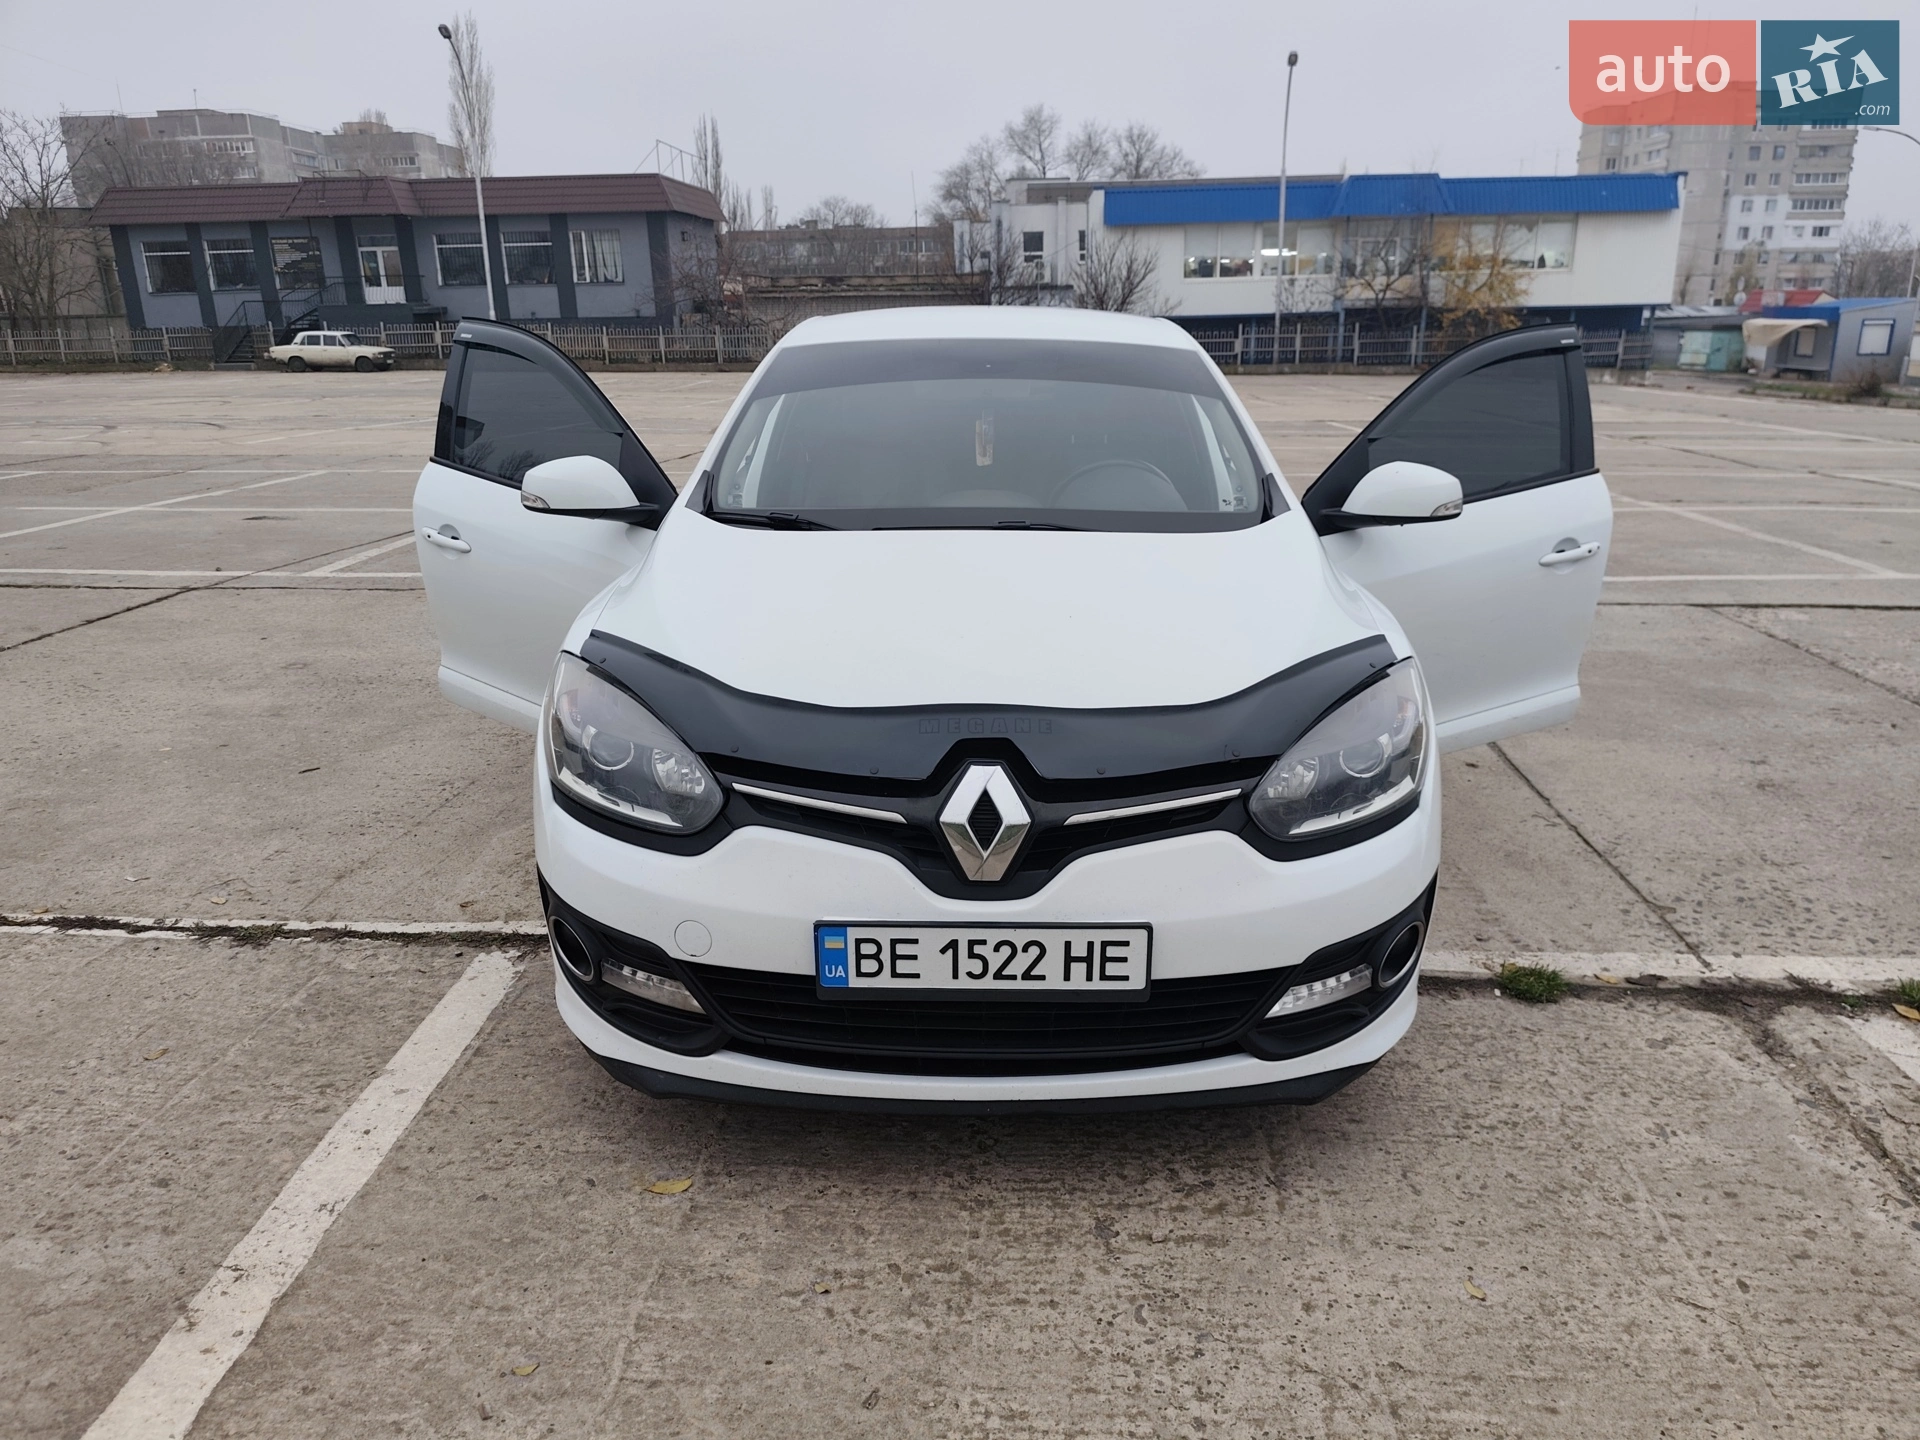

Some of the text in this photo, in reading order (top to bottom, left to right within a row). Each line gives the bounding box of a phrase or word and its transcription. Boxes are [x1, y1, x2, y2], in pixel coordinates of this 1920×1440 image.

[919, 717, 1053, 735] MEGANE
[854, 937, 1130, 982] BE 1522 HE
[825, 965, 846, 978] UA
